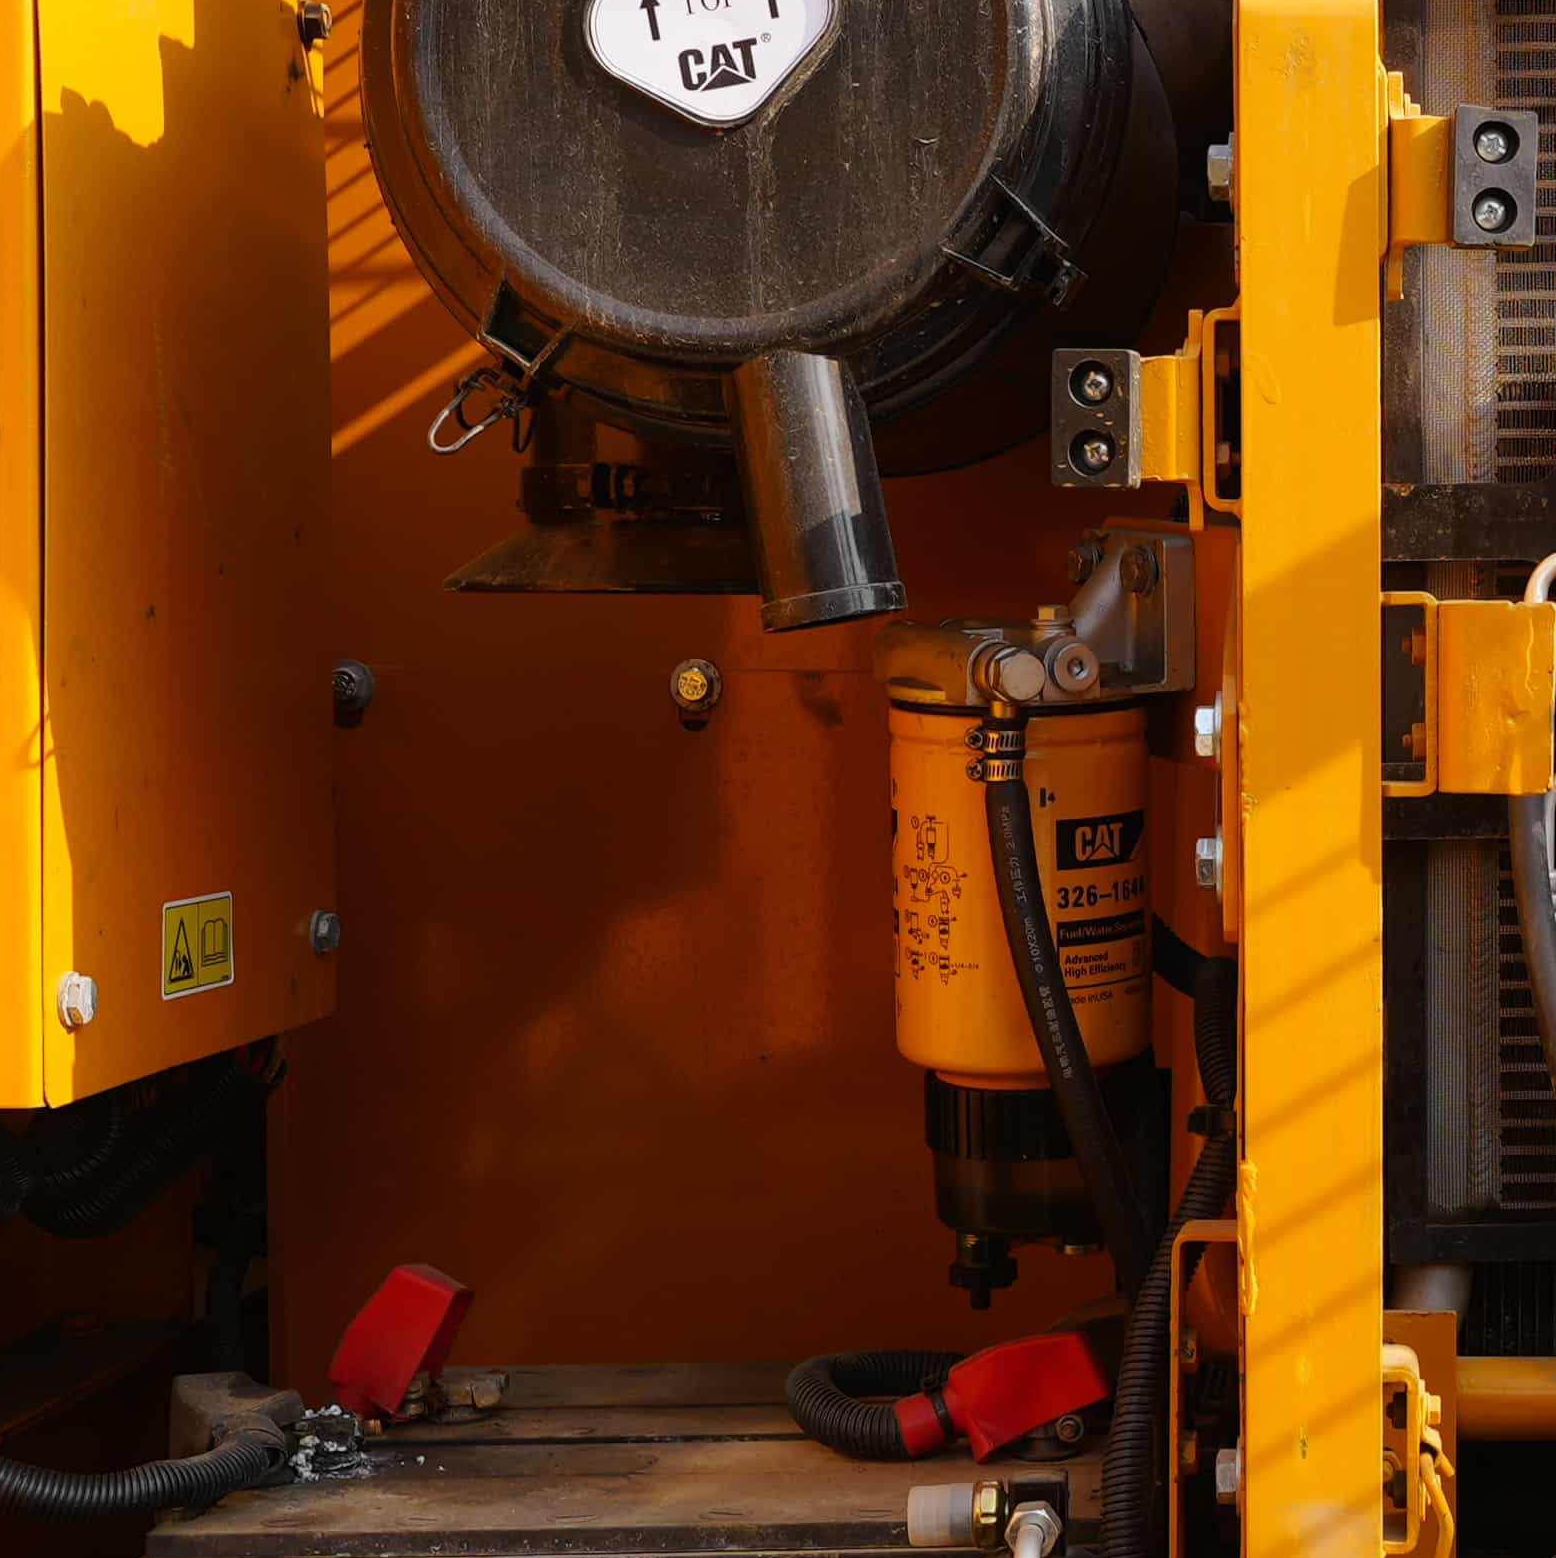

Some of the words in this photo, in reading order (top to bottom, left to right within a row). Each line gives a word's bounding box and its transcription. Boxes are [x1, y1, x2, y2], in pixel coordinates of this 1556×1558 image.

[678, 37, 758, 92] CAT
[1075, 823, 1123, 861] CAT
[1064, 950, 1109, 964] Advanced
[1064, 966, 1087, 979] High
